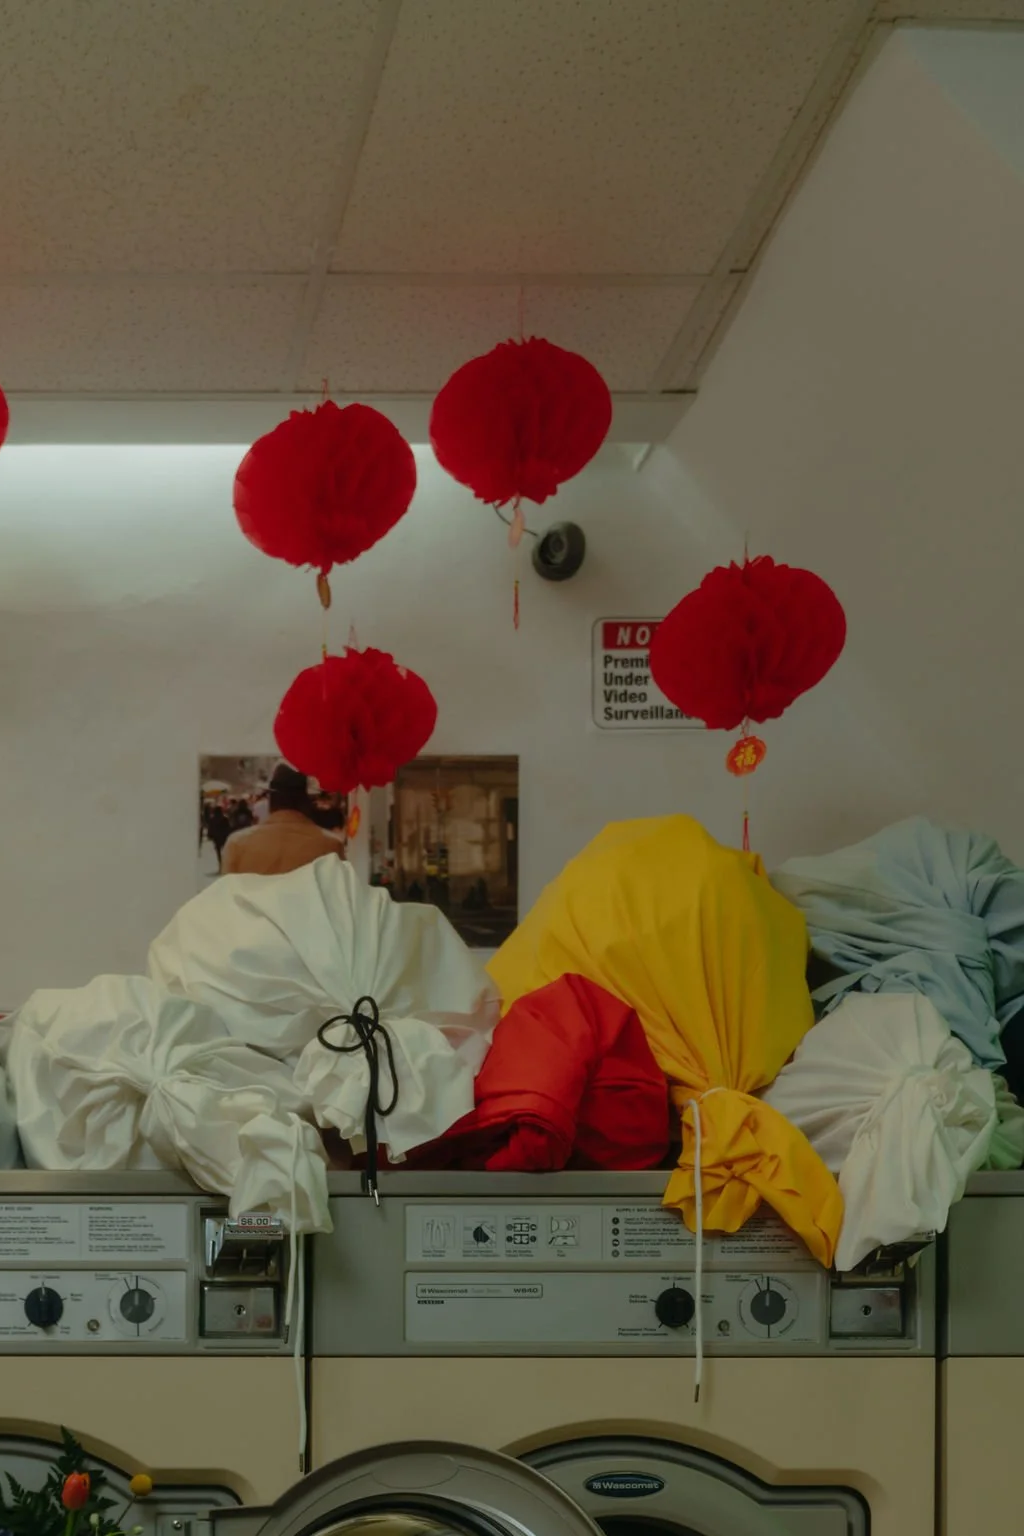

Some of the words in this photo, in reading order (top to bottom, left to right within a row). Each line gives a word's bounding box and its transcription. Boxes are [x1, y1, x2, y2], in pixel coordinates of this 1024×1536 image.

[616, 626, 658, 646] NO
[603, 672, 650, 687] Under
[603, 689, 648, 704] Video
[603, 706, 698, 721] Surveillan
[240, 1217, 269, 1226] $6.00
[602, 1481, 659, 1489] Wascomat
